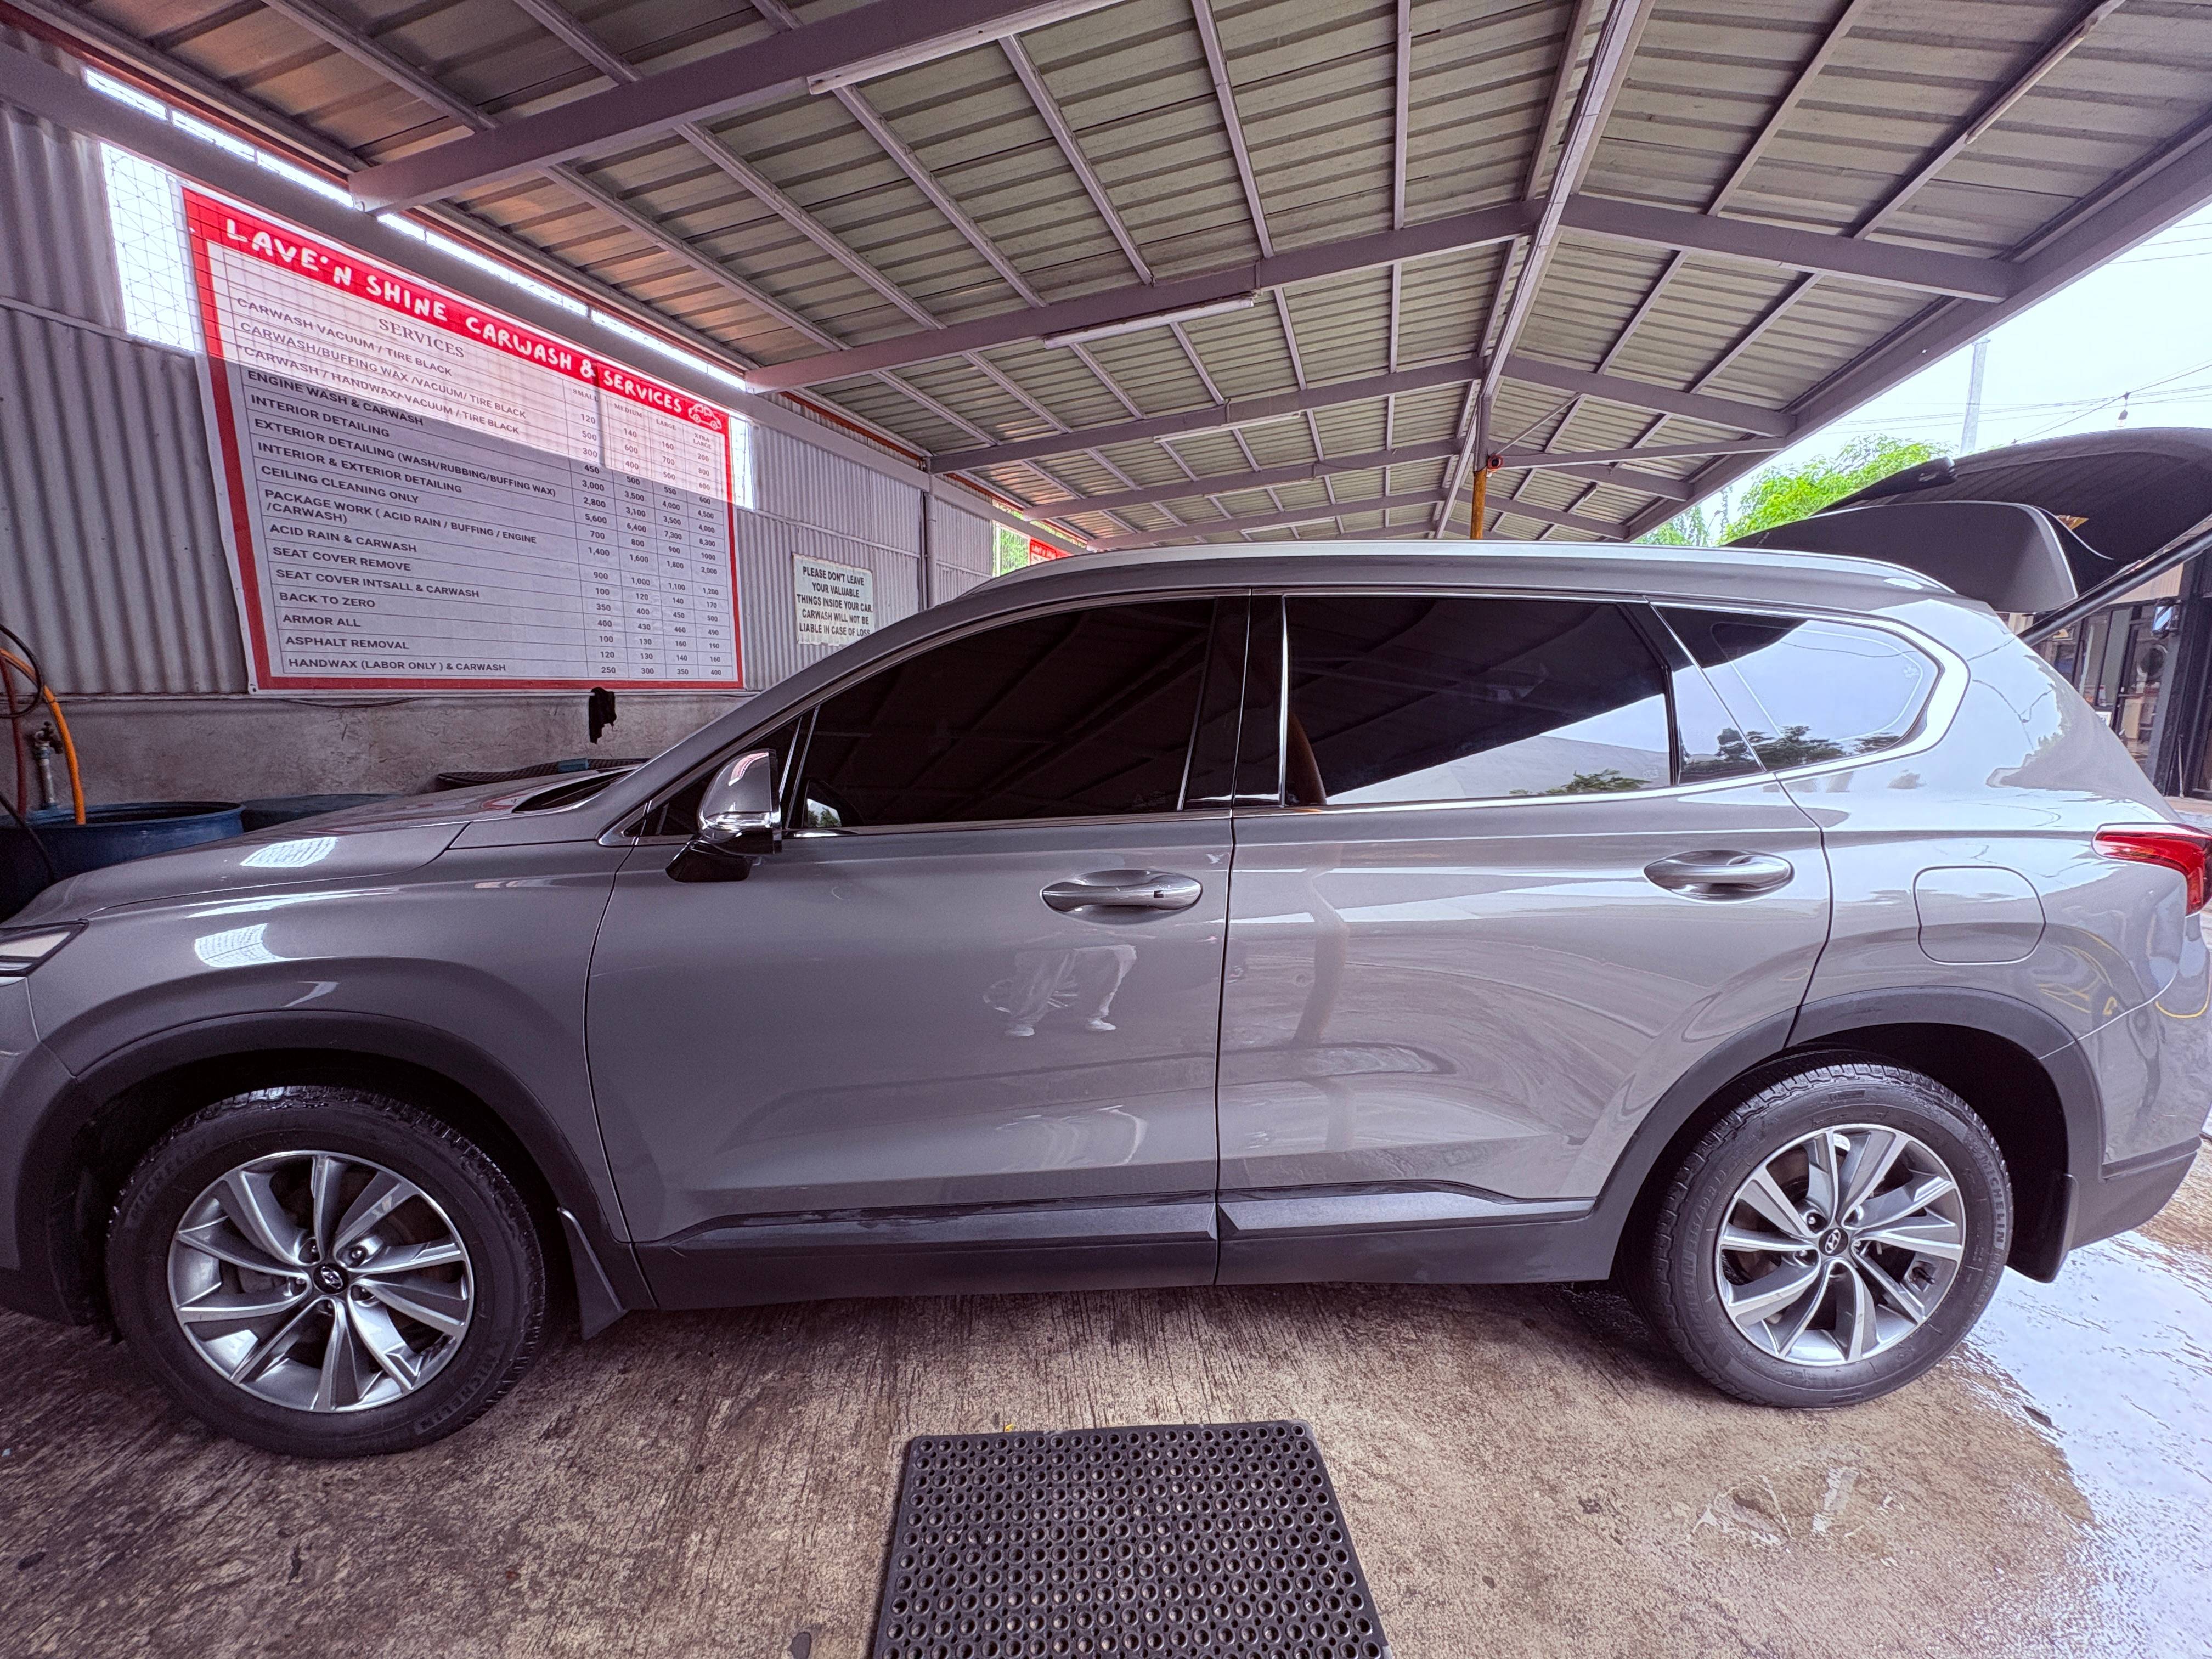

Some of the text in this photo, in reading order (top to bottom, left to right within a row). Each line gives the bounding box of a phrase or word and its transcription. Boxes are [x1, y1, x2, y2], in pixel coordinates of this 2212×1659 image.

[238, 298, 452, 376] CARWASH VACUUM TIRE BLACK
[366, 275, 448, 321] SHINE
[465, 317, 572, 370] CARWASH
[579, 359, 596, 379] &
[603, 370, 682, 413] SERVICES
[379, 318, 464, 358] SERVICES
[245, 347, 319, 376] CARWASH
[404, 393, 453, 415] VACUUM
[462, 411, 485, 425] TIRE
[488, 419, 519, 435] BLACK
[248, 370, 424, 426] ENGINE WASH & CARWASH
[380, 366, 408, 382] WAX
[470, 394, 492, 409] TIRE
[495, 403, 526, 419] BLACK
[251, 394, 390, 437] INTERIOR DETAILING
[573, 388, 676, 431] SMALL MEDIUM LARGE
[255, 418, 325, 443] EXTERIOR
[329, 436, 395, 459] DETAILING
[580, 414, 709, 462] 120 140 160 200
[582, 431, 709, 476] 500 600 700 800
[693, 439, 712, 449] LARGE
[694, 432, 709, 442] XTRA
[258, 442, 462, 493] INTERIOR & EXTERIOR DETAILING
[262, 466, 419, 503] CEILING CLEANING ONLY
[584, 464, 710, 505] 450 500 550 600
[582, 479, 714, 519] 3,000 3,500 4,000 4,500
[583, 496, 715, 533] 2,800 3,100 3,500 4,000
[264, 489, 537, 544] PACKAGE WORK ACID RAIN BUFFING ENGINE
[585, 513, 715, 547] 5,600 6,400 7,300 8,300
[270, 524, 417, 552] ACID RAIN & CARWASH
[590, 530, 715, 561] 700 800 900 1000
[273, 546, 411, 571] SEAT COVER REMOVE
[588, 546, 717, 575] 1,400 1,600 1,800 2,000
[276, 569, 312, 581] SEAT
[315, 573, 359, 585] COVER
[363, 578, 413, 591] INTSALL
[426, 585, 479, 598] CARWASH
[594, 572, 608, 580] 900
[631, 577, 651, 586] 1,000
[668, 583, 685, 591] 1,100
[595, 588, 610, 596] 100
[803, 566, 864, 586] PLEASE DON'T LEAVE
[812, 582, 860, 598] YOUR VALUABLE
[279, 592, 376, 608] BACK TO ZERO
[797, 594, 821, 606] THINGS
[823, 597, 842, 608] INSIDE
[844, 601, 859, 611] YOUR
[802, 608, 869, 625] CARWASH WILL NOT BE
[283, 614, 361, 627] ARMOR ALL
[799, 622, 870, 637] LIABLE IN CASE OF LOSS
[285, 636, 410, 650] ASPHALT REMOVAL
[289, 658, 358, 668] HANDWAX
[408, 662, 436, 670] ONLY
[456, 663, 506, 671] CARWASH
[1979, 1155, 2005, 1243] MICHELIN
